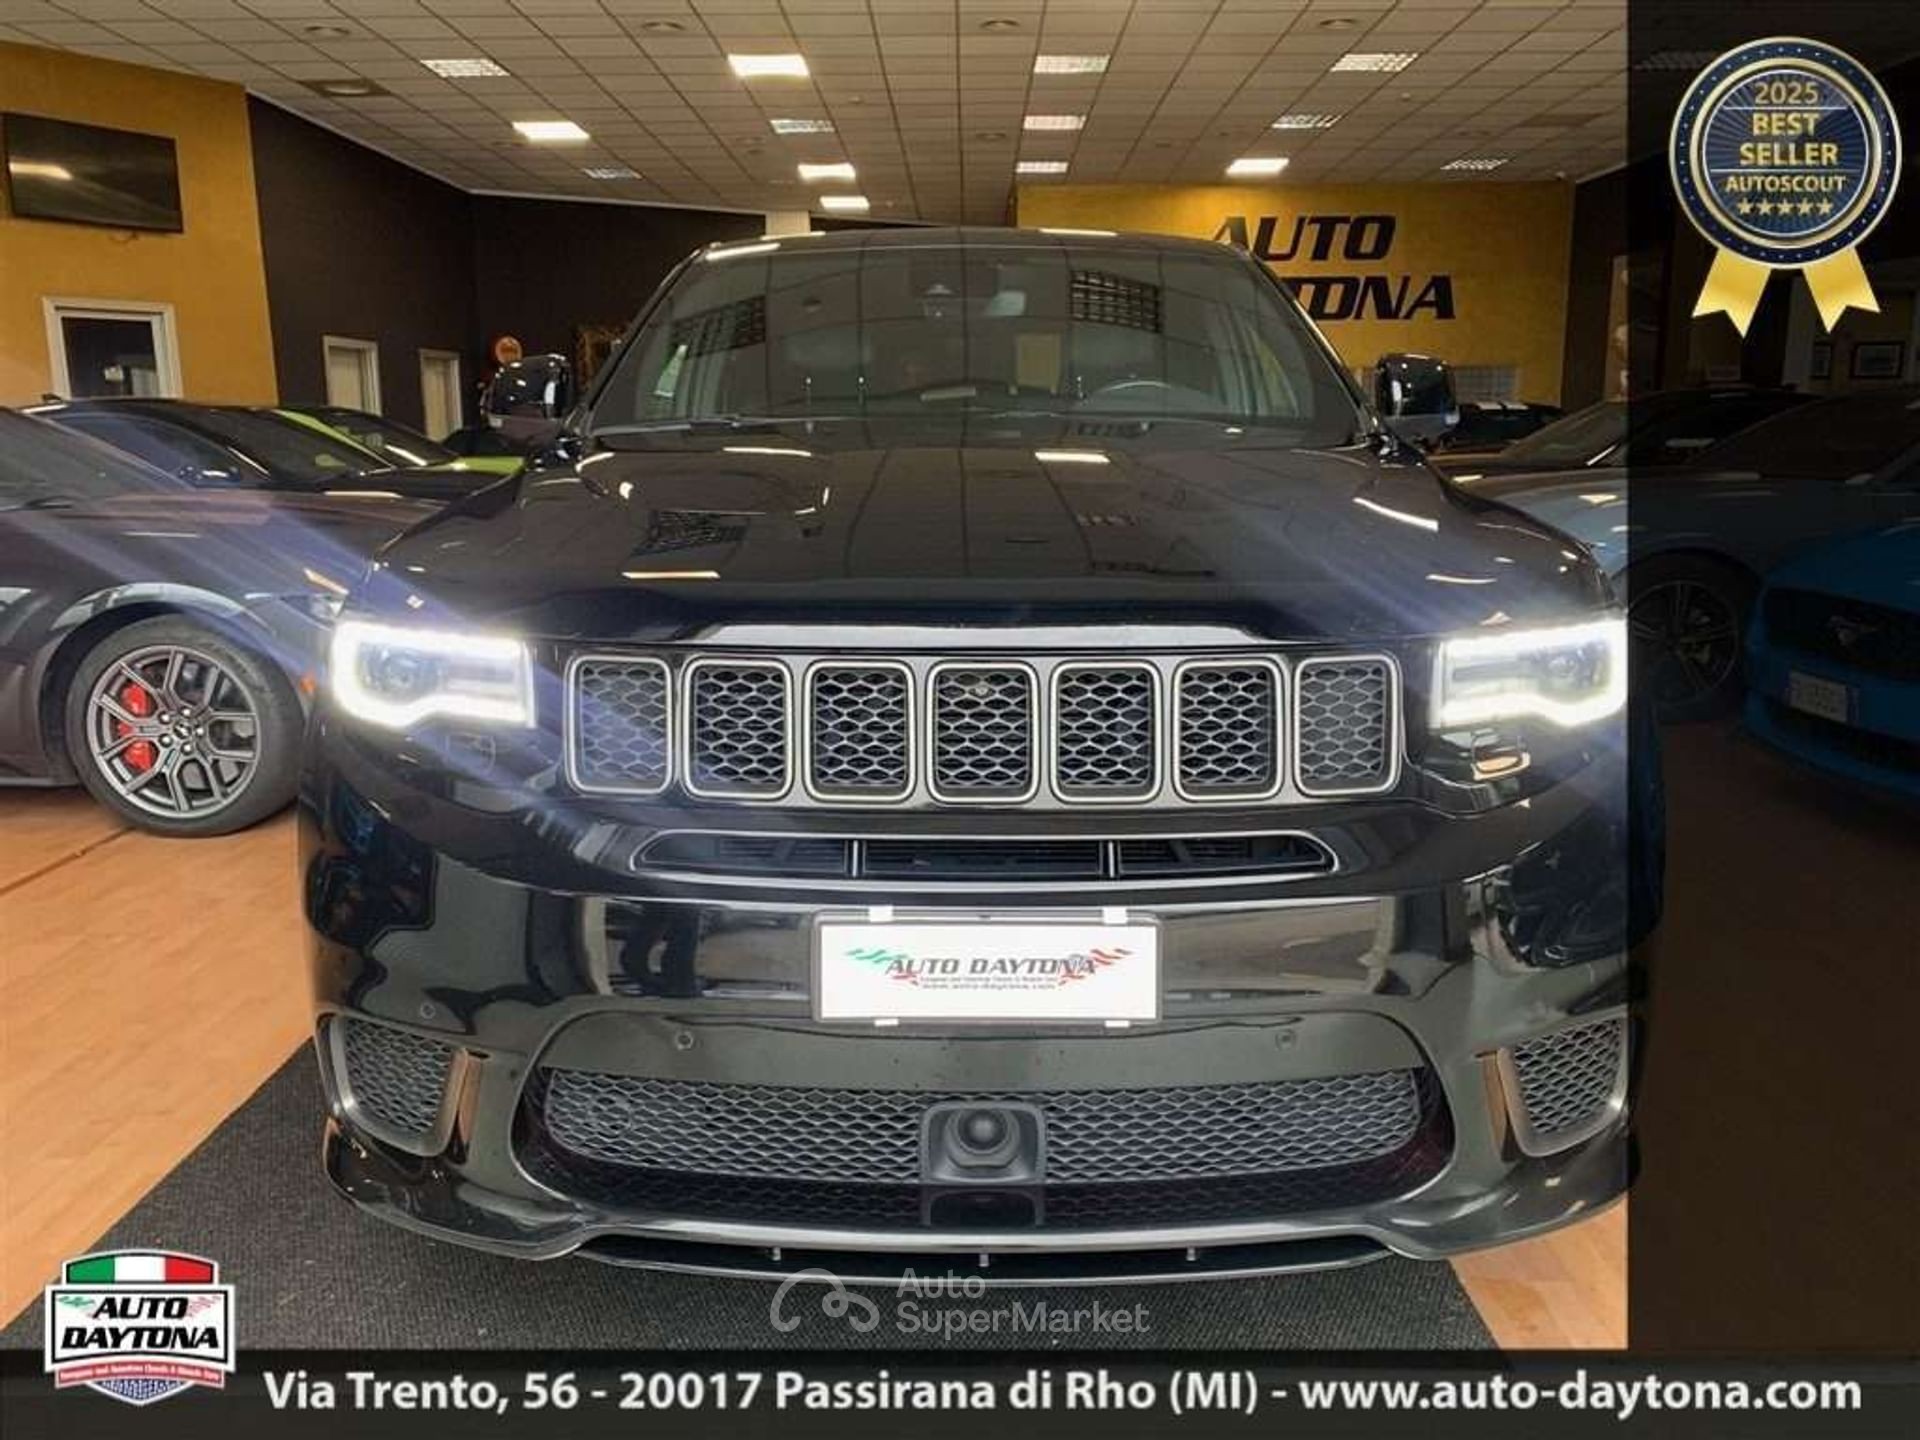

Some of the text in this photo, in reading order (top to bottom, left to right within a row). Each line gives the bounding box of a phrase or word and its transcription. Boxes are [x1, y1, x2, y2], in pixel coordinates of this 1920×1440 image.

[1213, 216, 1396, 261] AUTO
[1279, 275, 1456, 320] TONA
[886, 956, 1098, 975] AUTO DAYTONA
